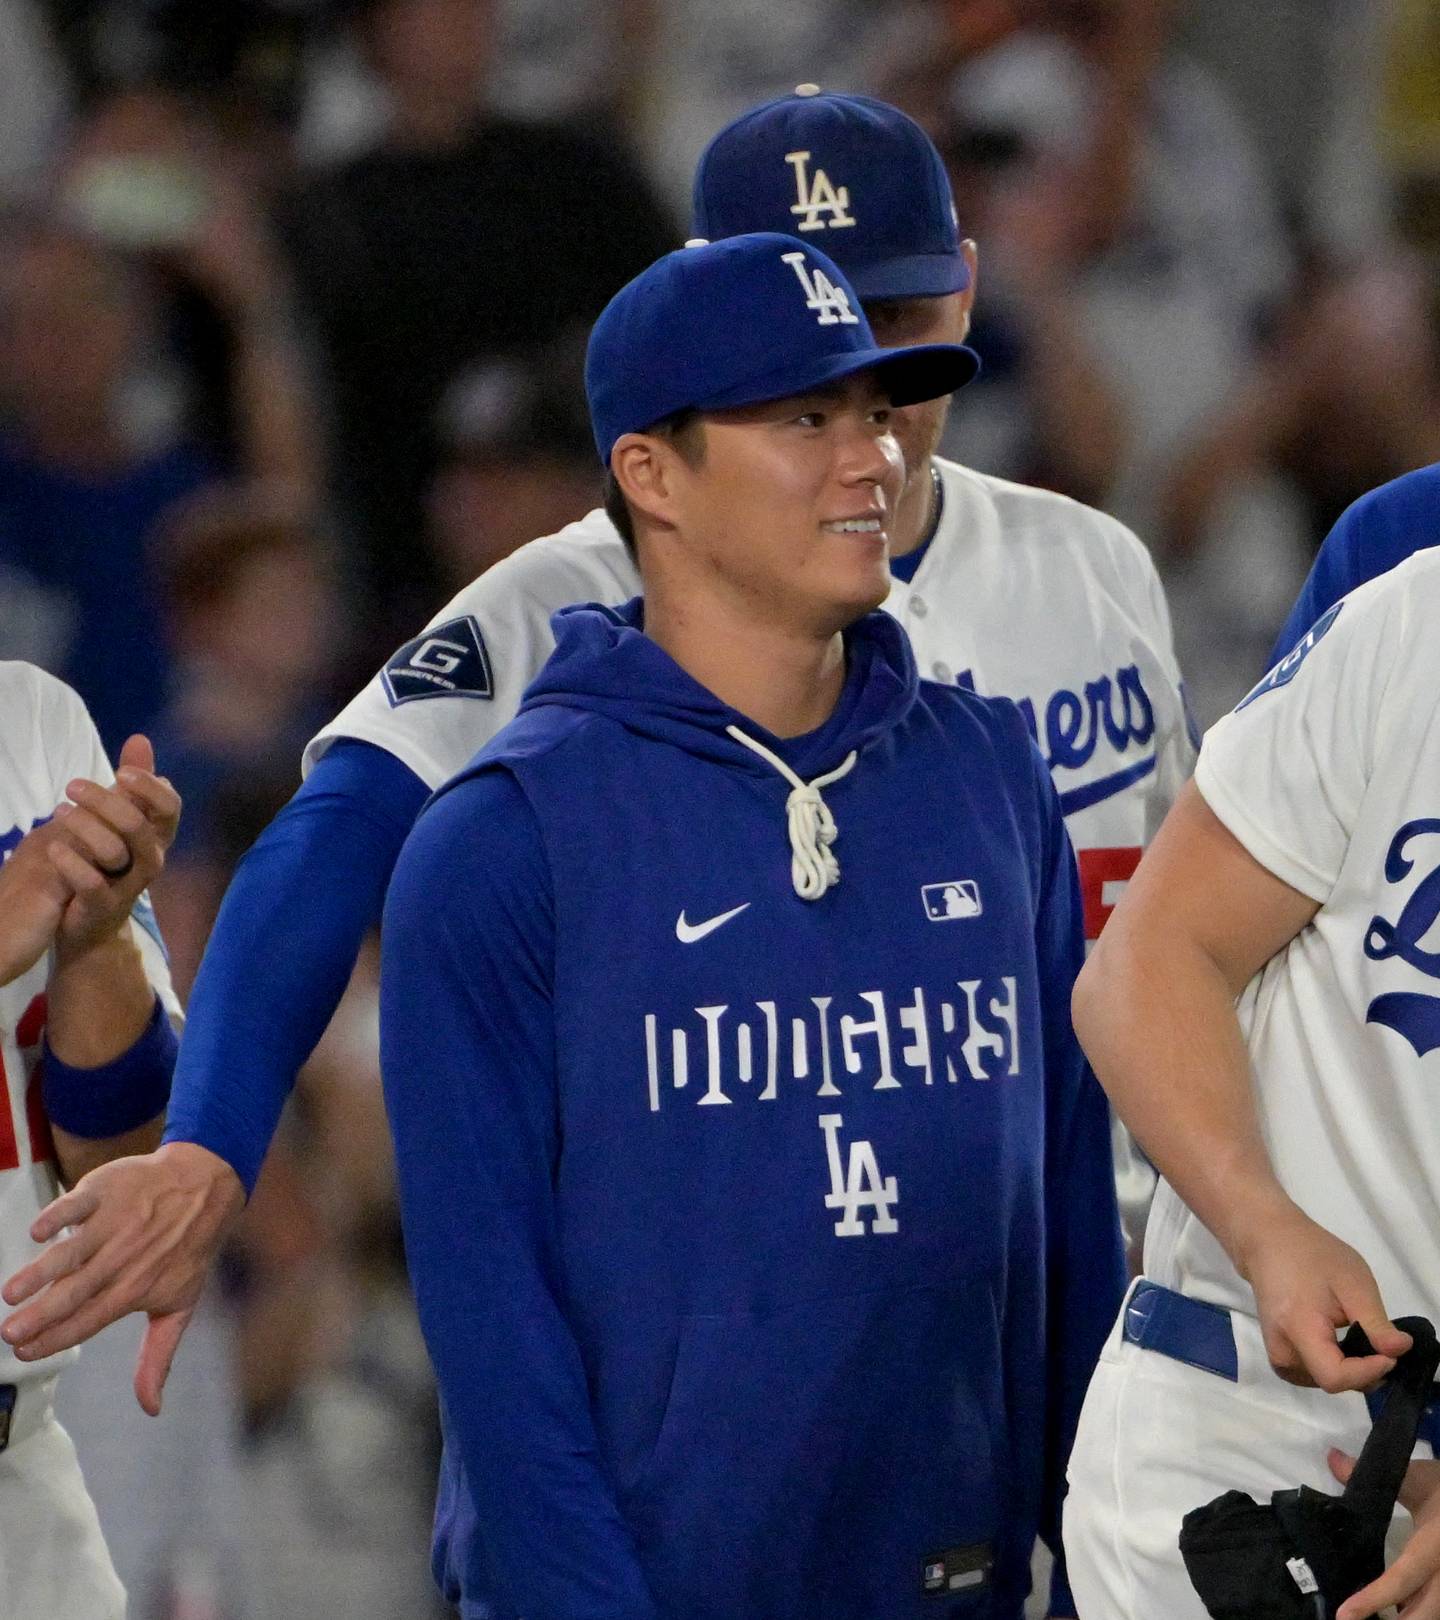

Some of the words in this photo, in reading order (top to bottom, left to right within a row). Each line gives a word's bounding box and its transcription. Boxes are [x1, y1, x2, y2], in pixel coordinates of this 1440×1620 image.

[784, 151, 856, 231] LA
[781, 252, 859, 325] LA
[645, 976, 1021, 1112] DODGERS
[818, 1113, 900, 1238] LA
